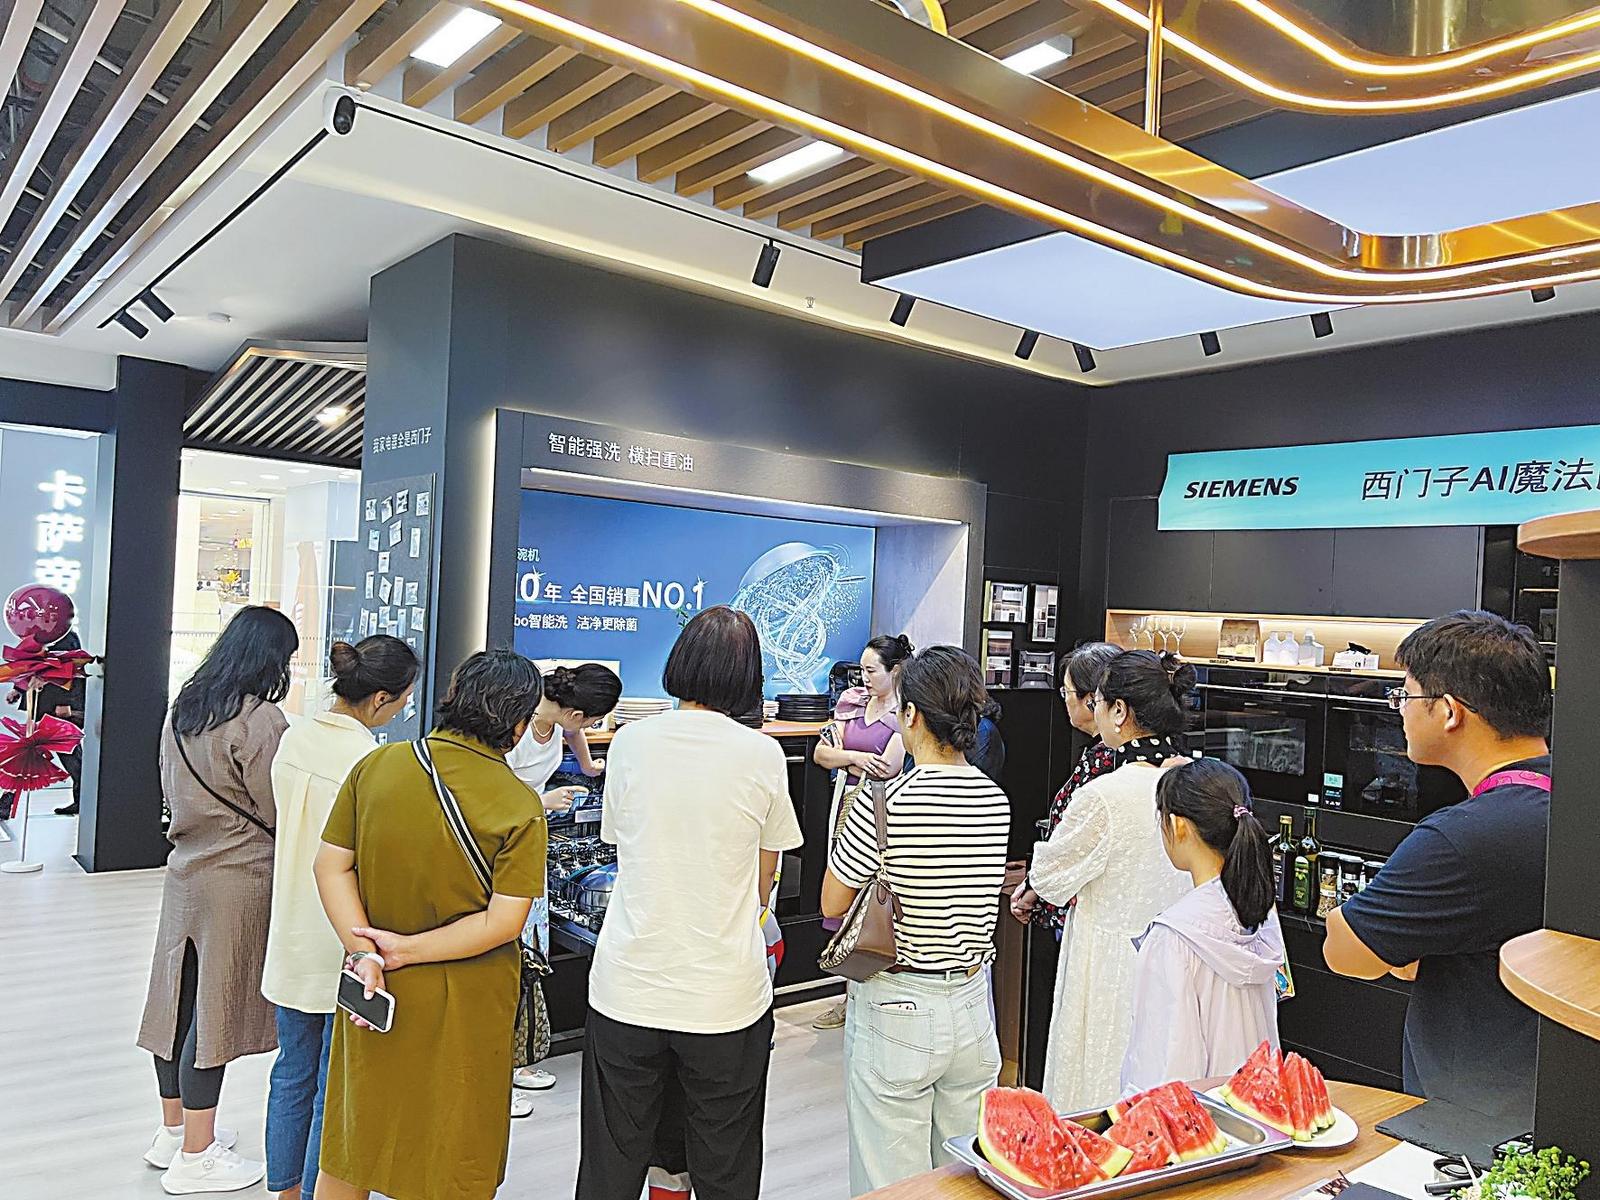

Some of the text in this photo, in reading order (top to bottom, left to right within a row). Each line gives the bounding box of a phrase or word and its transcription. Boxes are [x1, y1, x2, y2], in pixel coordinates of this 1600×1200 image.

[373, 427, 432, 454] 我家电器全是西门子
[548, 432, 694, 472] 智能强洗 横扫重油
[1184, 457, 1600, 500] SIEMENS 西门子AI魔法
[36, 469, 86, 593] 卡萨帝
[577, 615, 638, 632] 洁净更除菌
